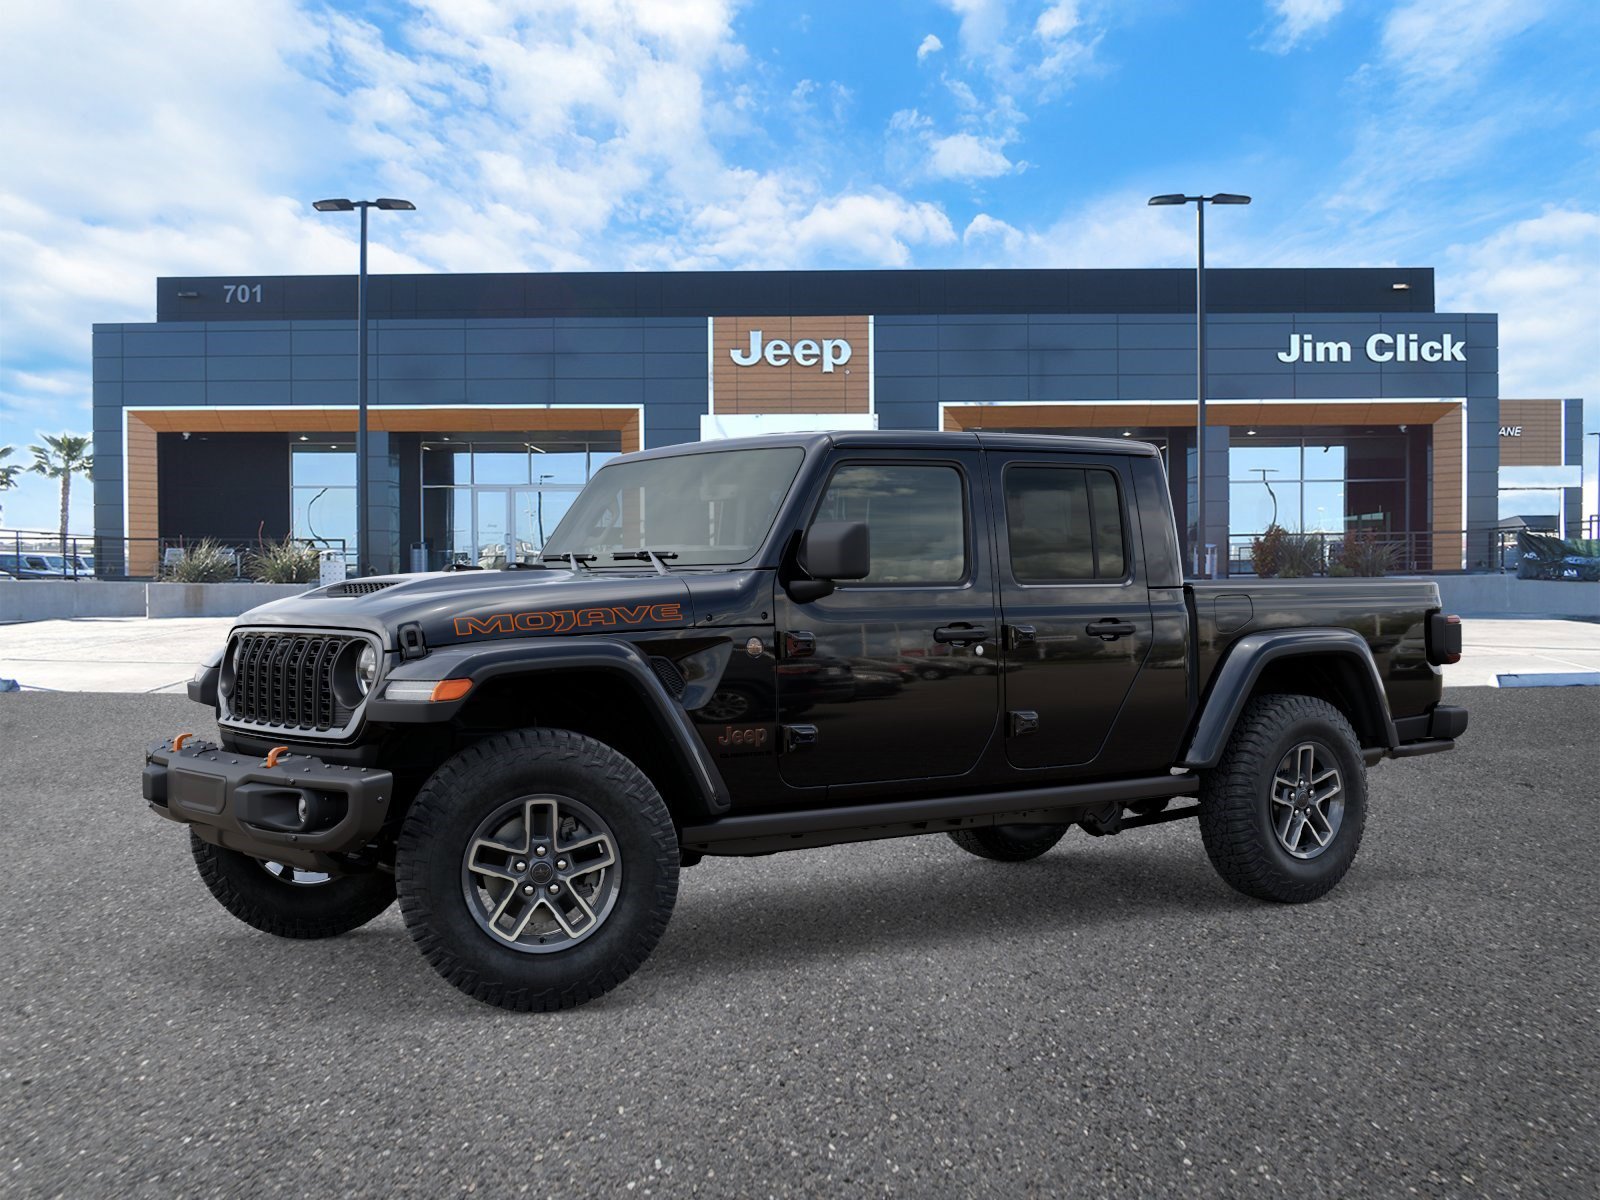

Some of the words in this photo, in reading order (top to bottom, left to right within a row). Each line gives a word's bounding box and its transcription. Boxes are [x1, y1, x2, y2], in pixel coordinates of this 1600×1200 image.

[223, 284, 262, 303] 701
[730, 330, 852, 373] Jeep
[1277, 333, 1351, 362] Jim
[1365, 333, 1467, 362] Click
[453, 603, 683, 636] MOJAVE
[718, 725, 768, 747] Jeep
